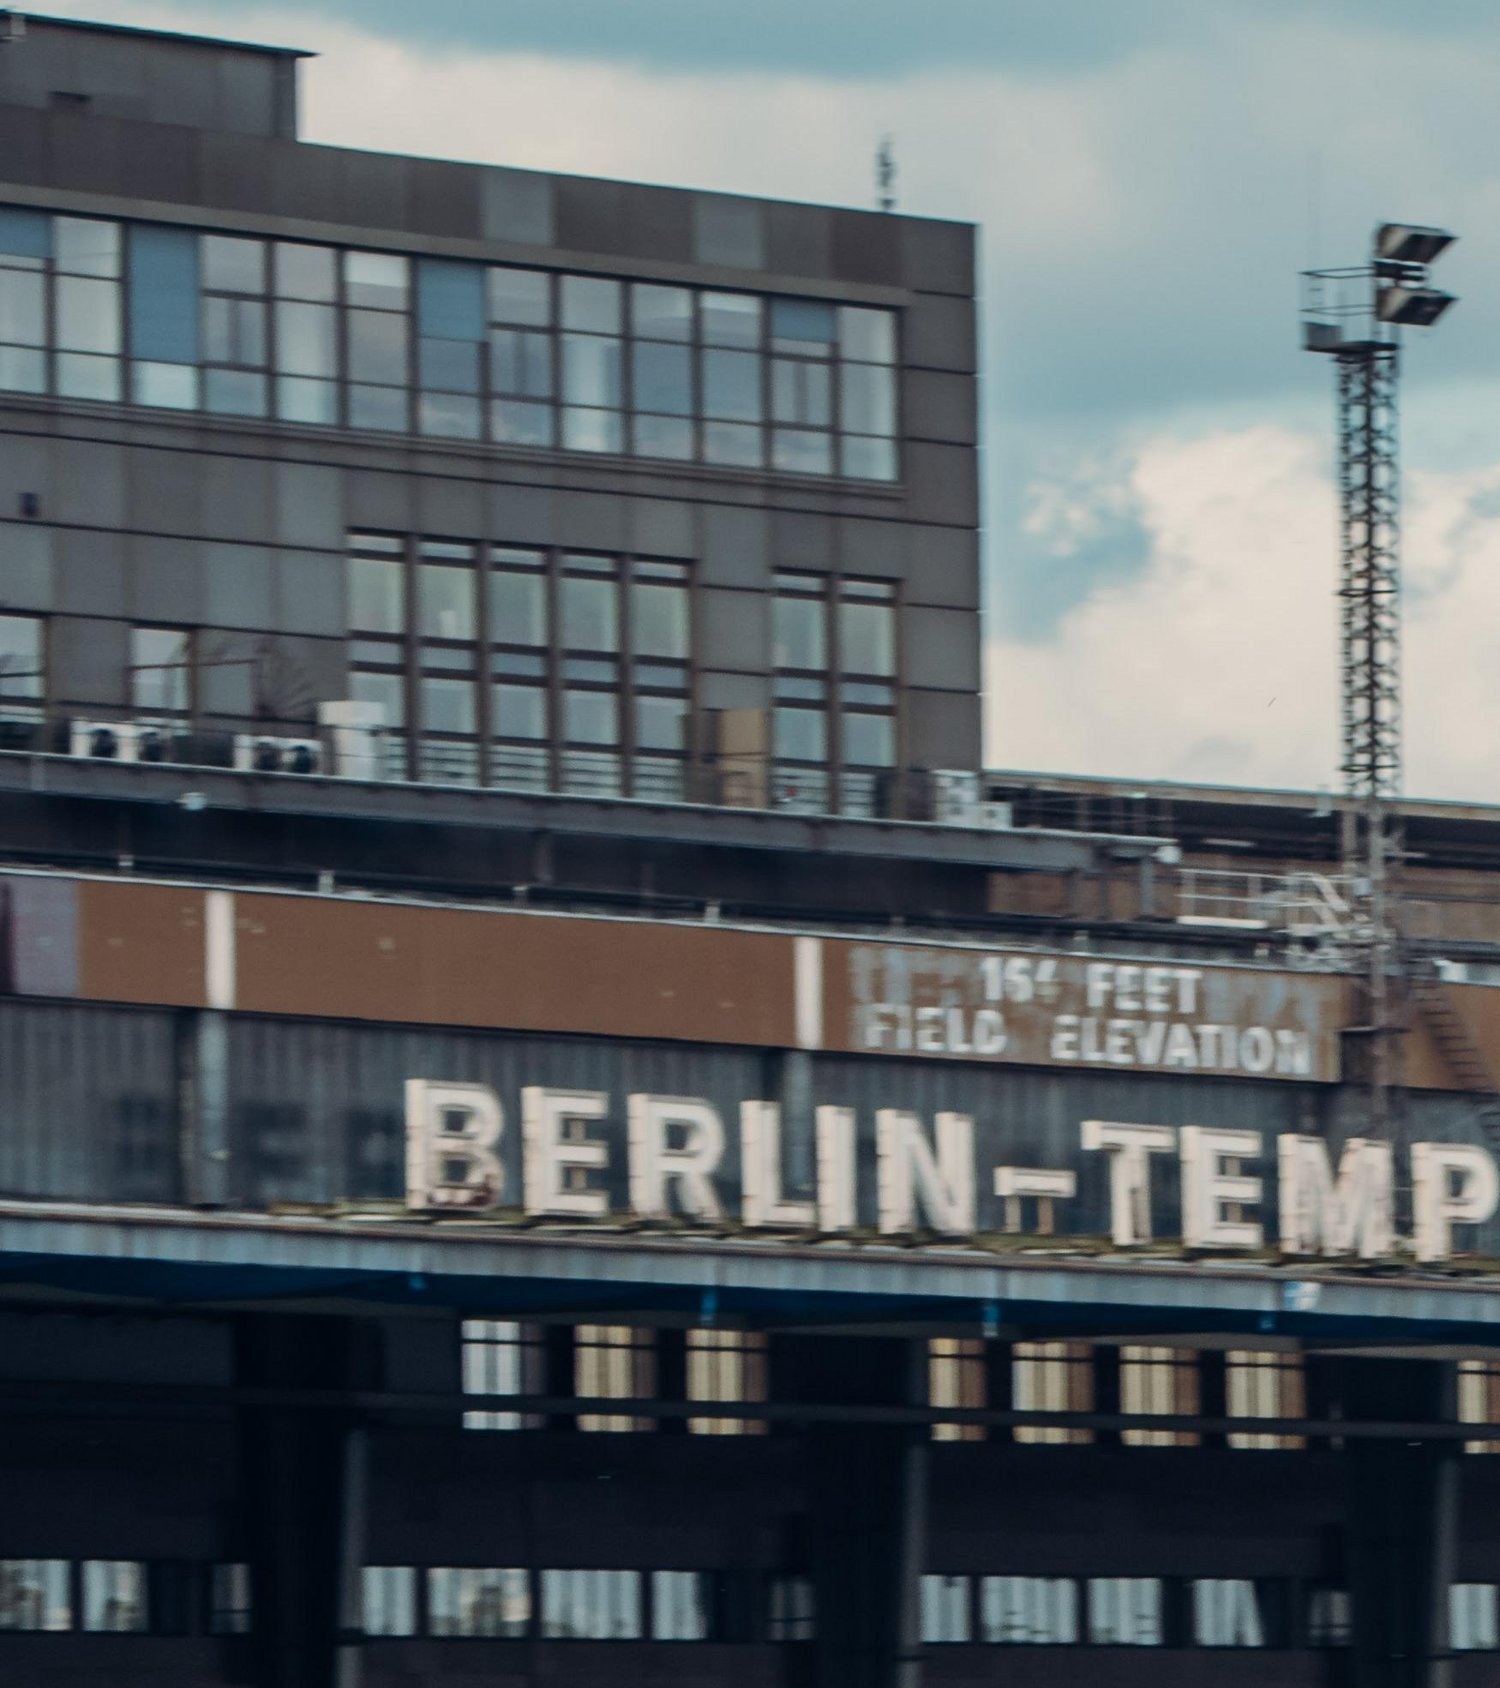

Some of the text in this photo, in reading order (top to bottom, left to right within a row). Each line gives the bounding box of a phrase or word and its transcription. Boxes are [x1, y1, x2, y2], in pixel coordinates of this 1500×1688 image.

[1087, 964, 1202, 1015] FEET
[864, 1003, 1311, 1075] FIELD ELEVATION
